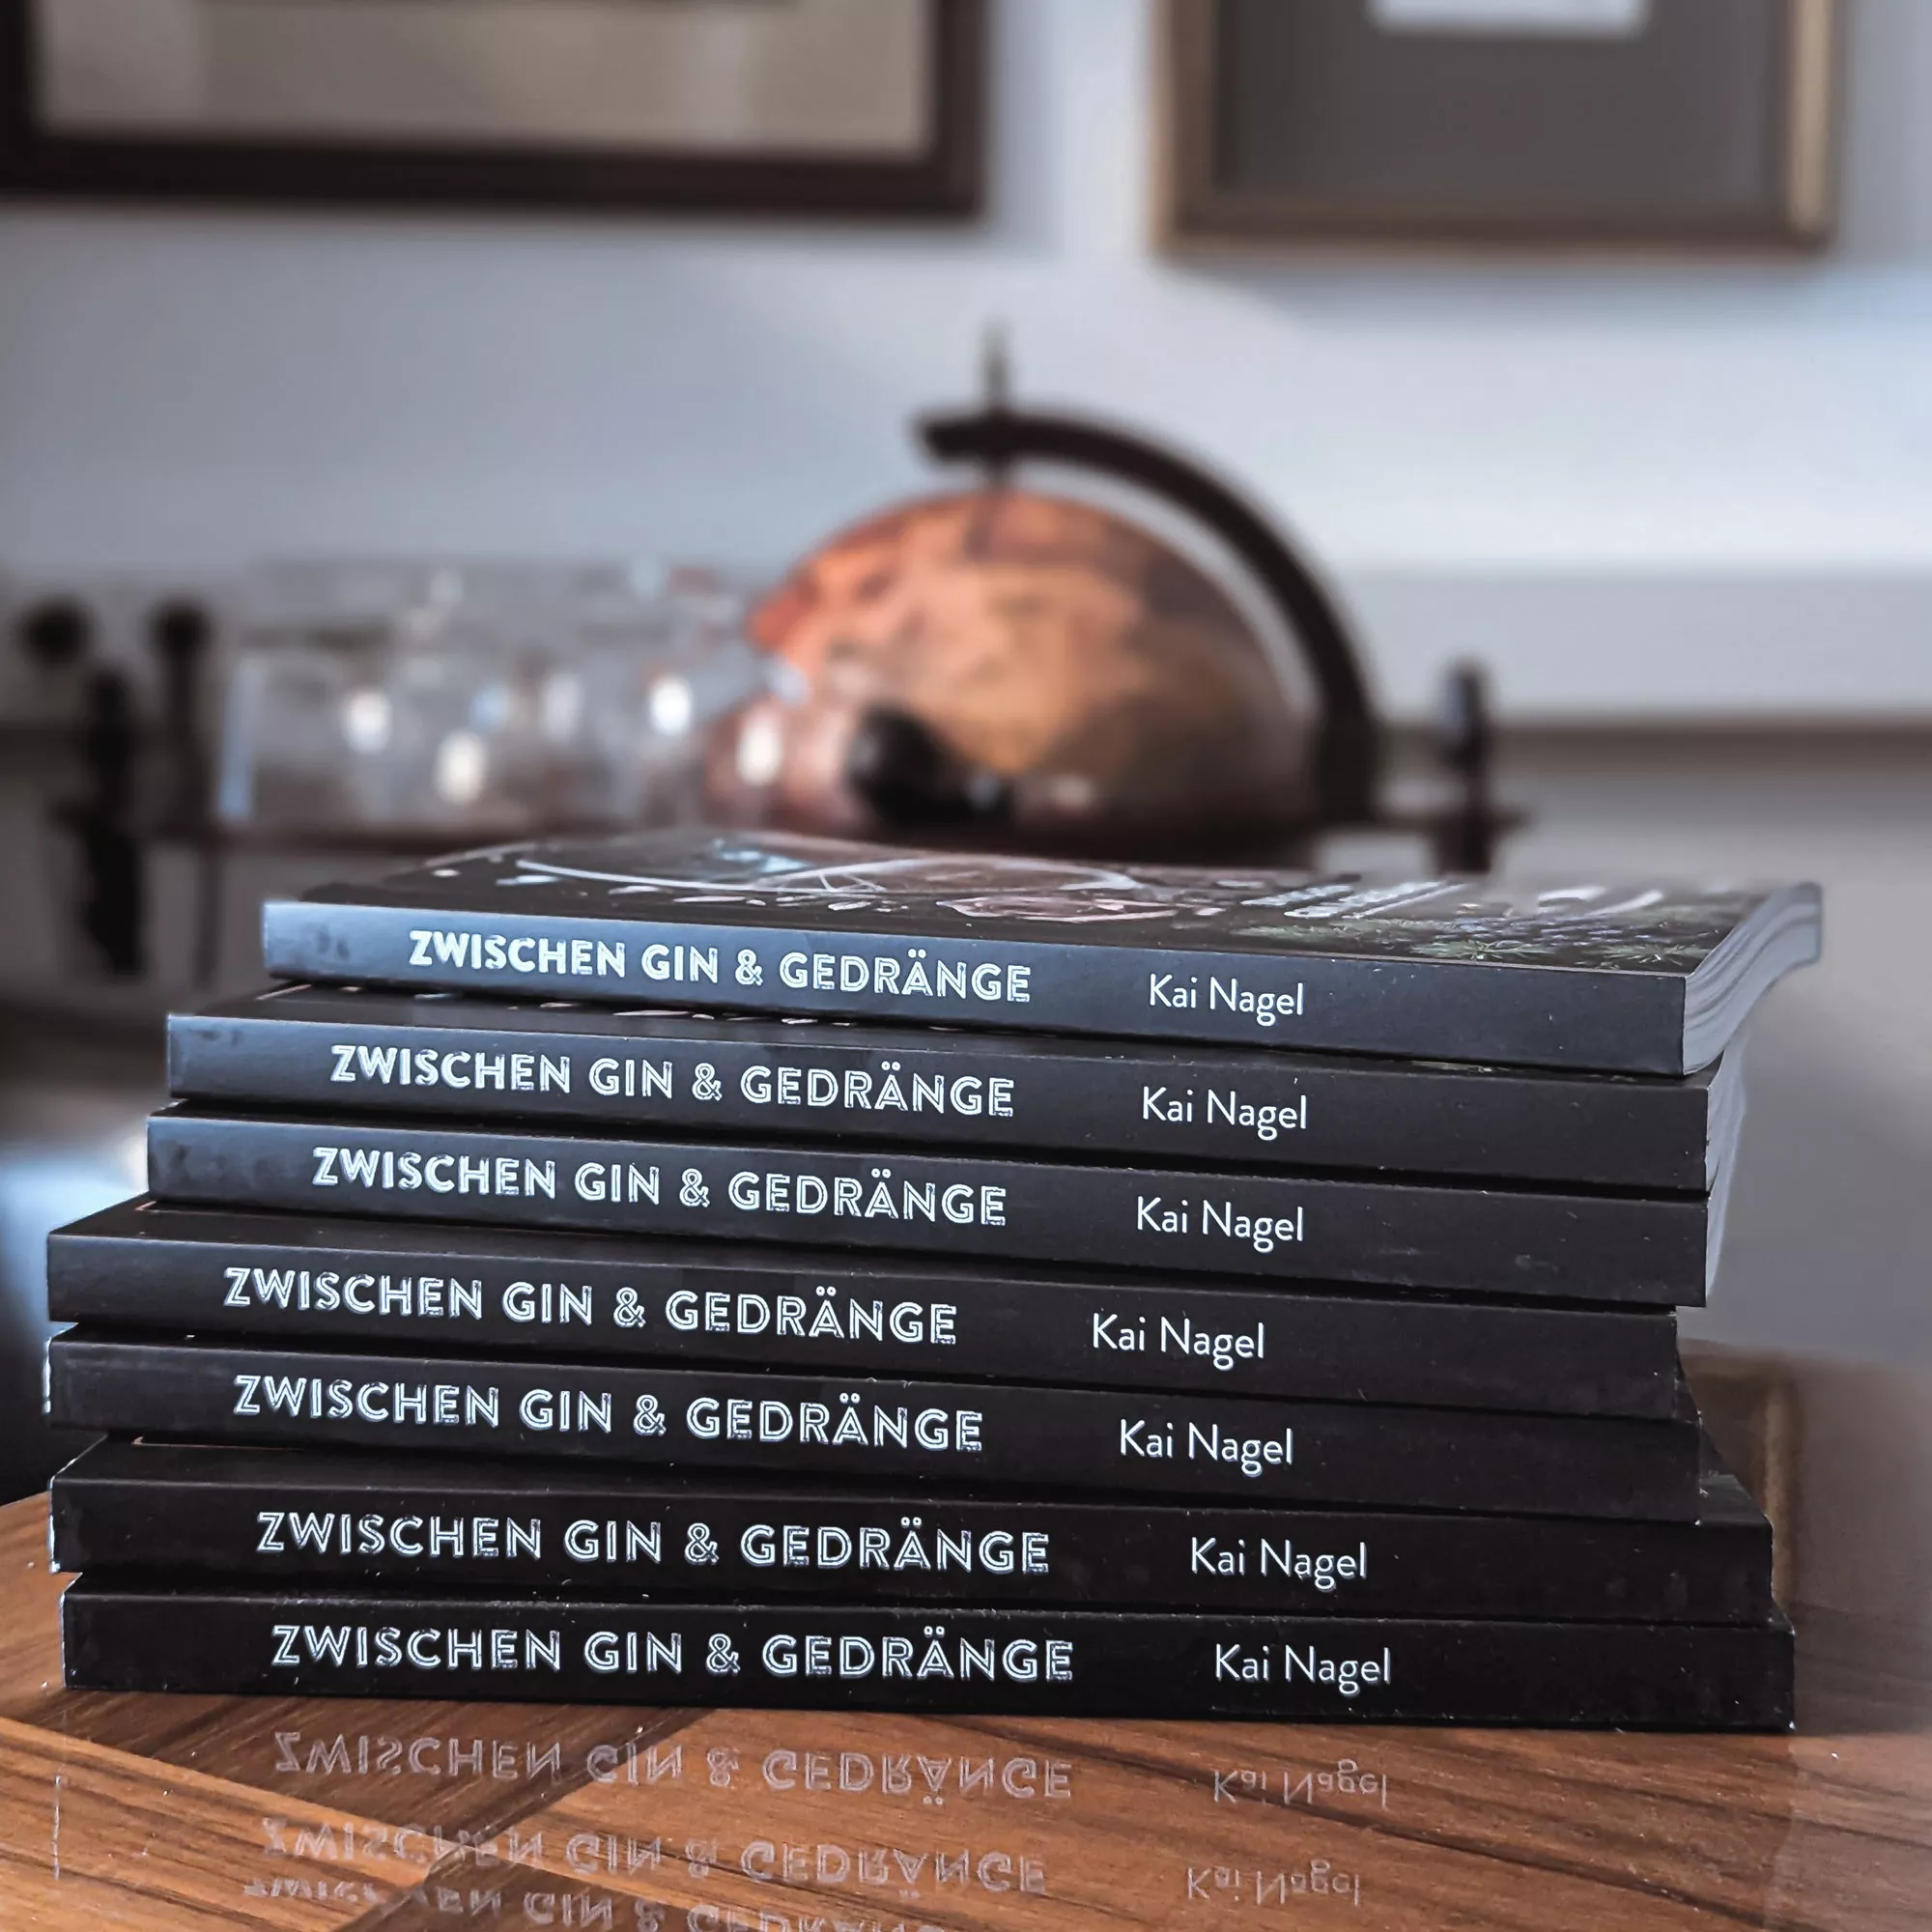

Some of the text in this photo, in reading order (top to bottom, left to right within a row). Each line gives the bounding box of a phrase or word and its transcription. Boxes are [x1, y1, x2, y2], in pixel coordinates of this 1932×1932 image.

[409, 929, 1032, 1003] ZWISCHEN GIN & GEDRÄNGE
[1150, 973, 1304, 1027] Kai Nagel
[329, 1044, 1015, 1118] ZWISCHEN GIN & GEDRÄNGE
[1142, 1086, 1307, 1142] Kai Nagel
[312, 1147, 1007, 1227] ZWISCHEN GIN & GEDRÄNGE
[1137, 1195, 1304, 1254] Kai Nagel
[223, 1266, 957, 1346] ZWISCHEN GIN & GEDRÄNGE
[1093, 1312, 1265, 1372] Kai Nagel
[232, 1374, 983, 1453] ZWISCHEN GIN & GEDRÄNGE
[1120, 1418, 1293, 1478] Kai Nagel
[256, 1511, 1050, 1576] ZWISCHEN GIN & GEDRÄNGE
[1191, 1536, 1367, 1593] Kai Nagel
[270, 1624, 1074, 1683] ZWISCHEN GIN & GEDRÄNGE
[1214, 1642, 1392, 1697] Kai Nagel
